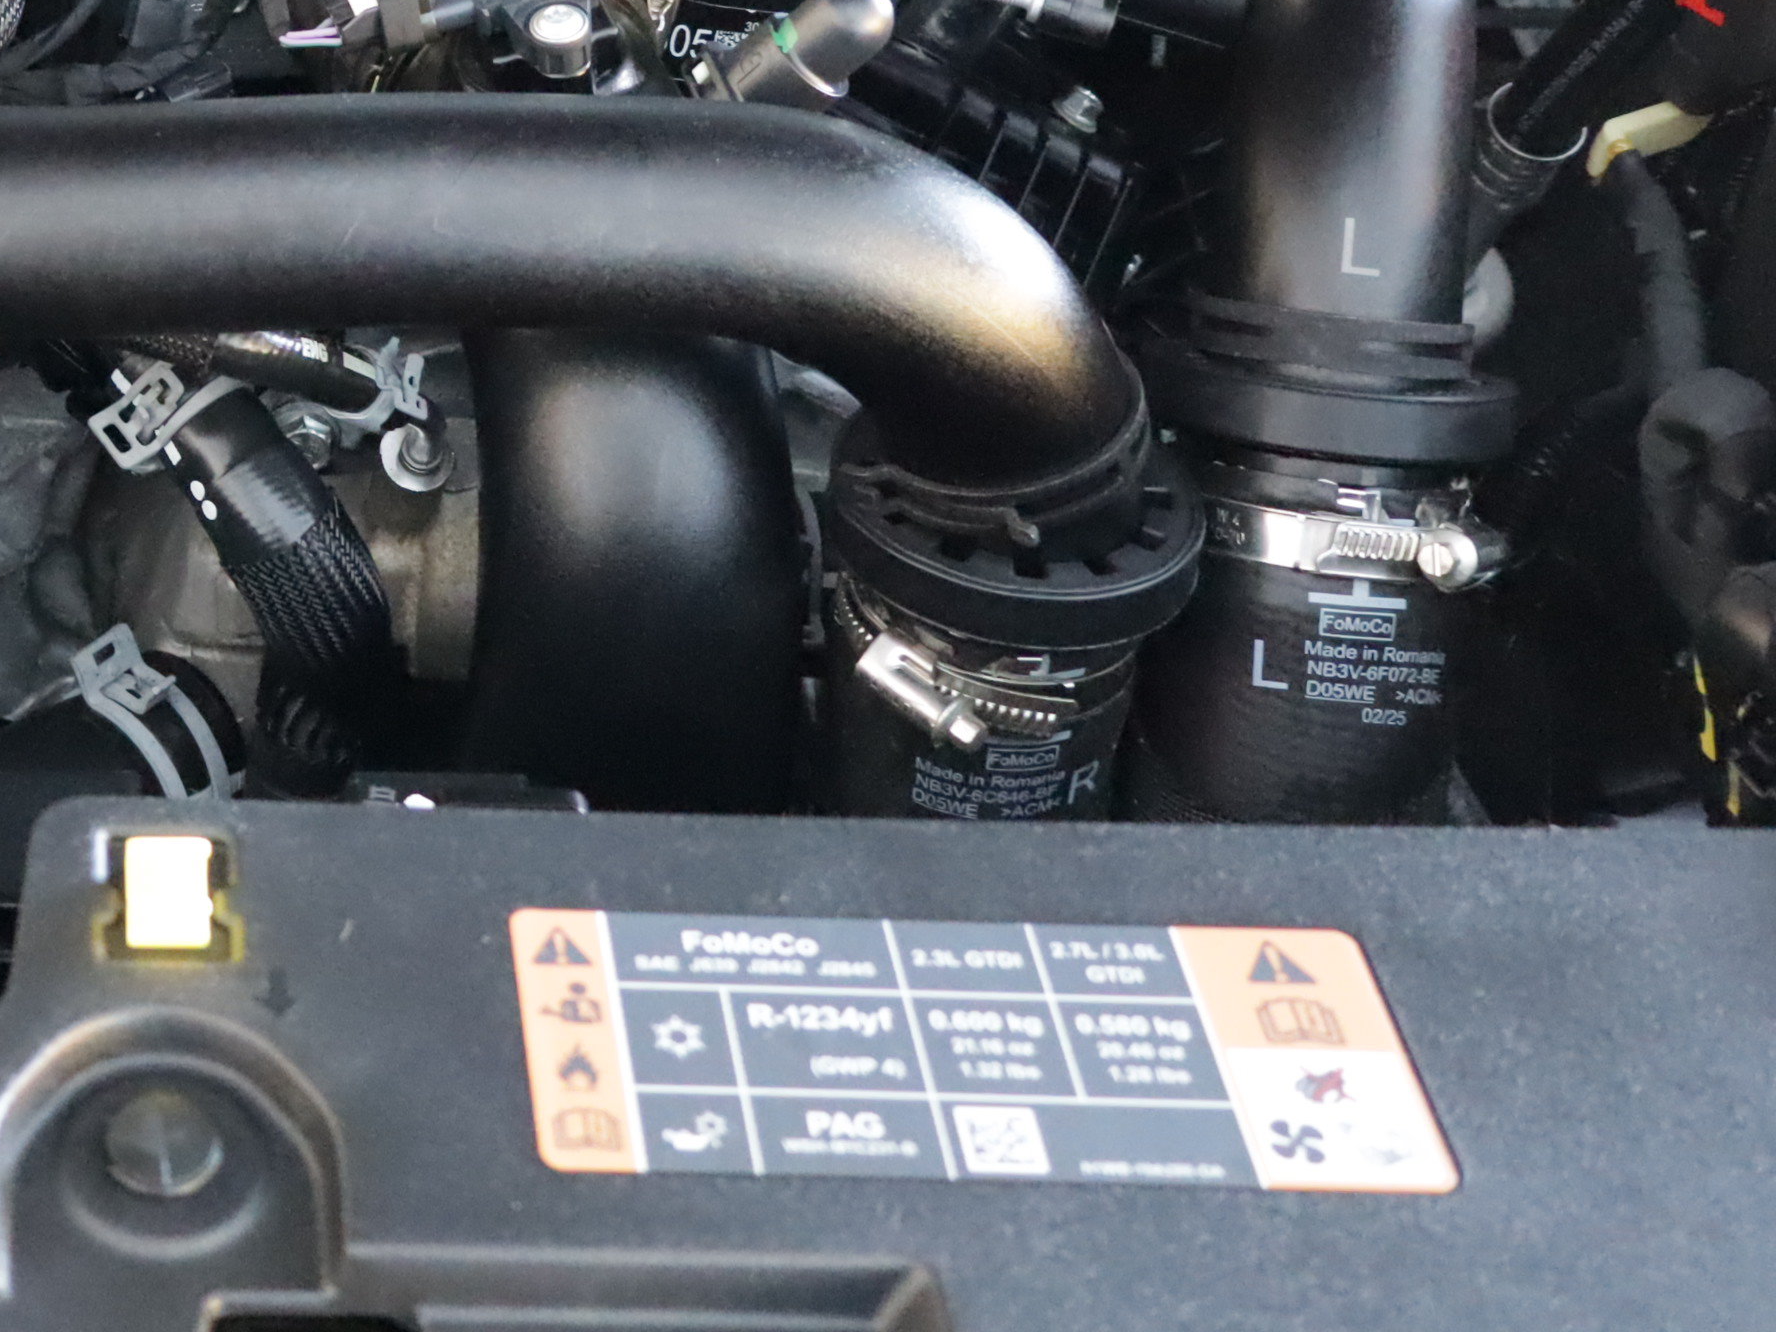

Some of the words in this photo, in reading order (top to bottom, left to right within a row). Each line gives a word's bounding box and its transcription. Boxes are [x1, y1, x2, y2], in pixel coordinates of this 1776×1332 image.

[1341, 218, 1380, 277] L
[1323, 615, 1393, 635] FoMoCo
[1252, 639, 1288, 690] L
[1304, 640, 1357, 660] Made
[1362, 645, 1379, 661] in
[1382, 647, 1446, 666] Romania
[1305, 680, 1376, 702] D05WE
[1362, 708, 1407, 726] 02/25
[915, 756, 964, 783] Made
[969, 769, 985, 786] in
[990, 768, 1066, 789] Romania
[989, 751, 1055, 767] FoMoCo
[1068, 760, 1100, 806] R
[912, 788, 979, 818] D05WE
[681, 929, 820, 957] FoMoCo
[746, 1002, 894, 1038] R-1234yf
[1005, 1011, 1045, 1038] kg
[1152, 1015, 1193, 1042] kg
[805, 1110, 887, 1139] PAG
